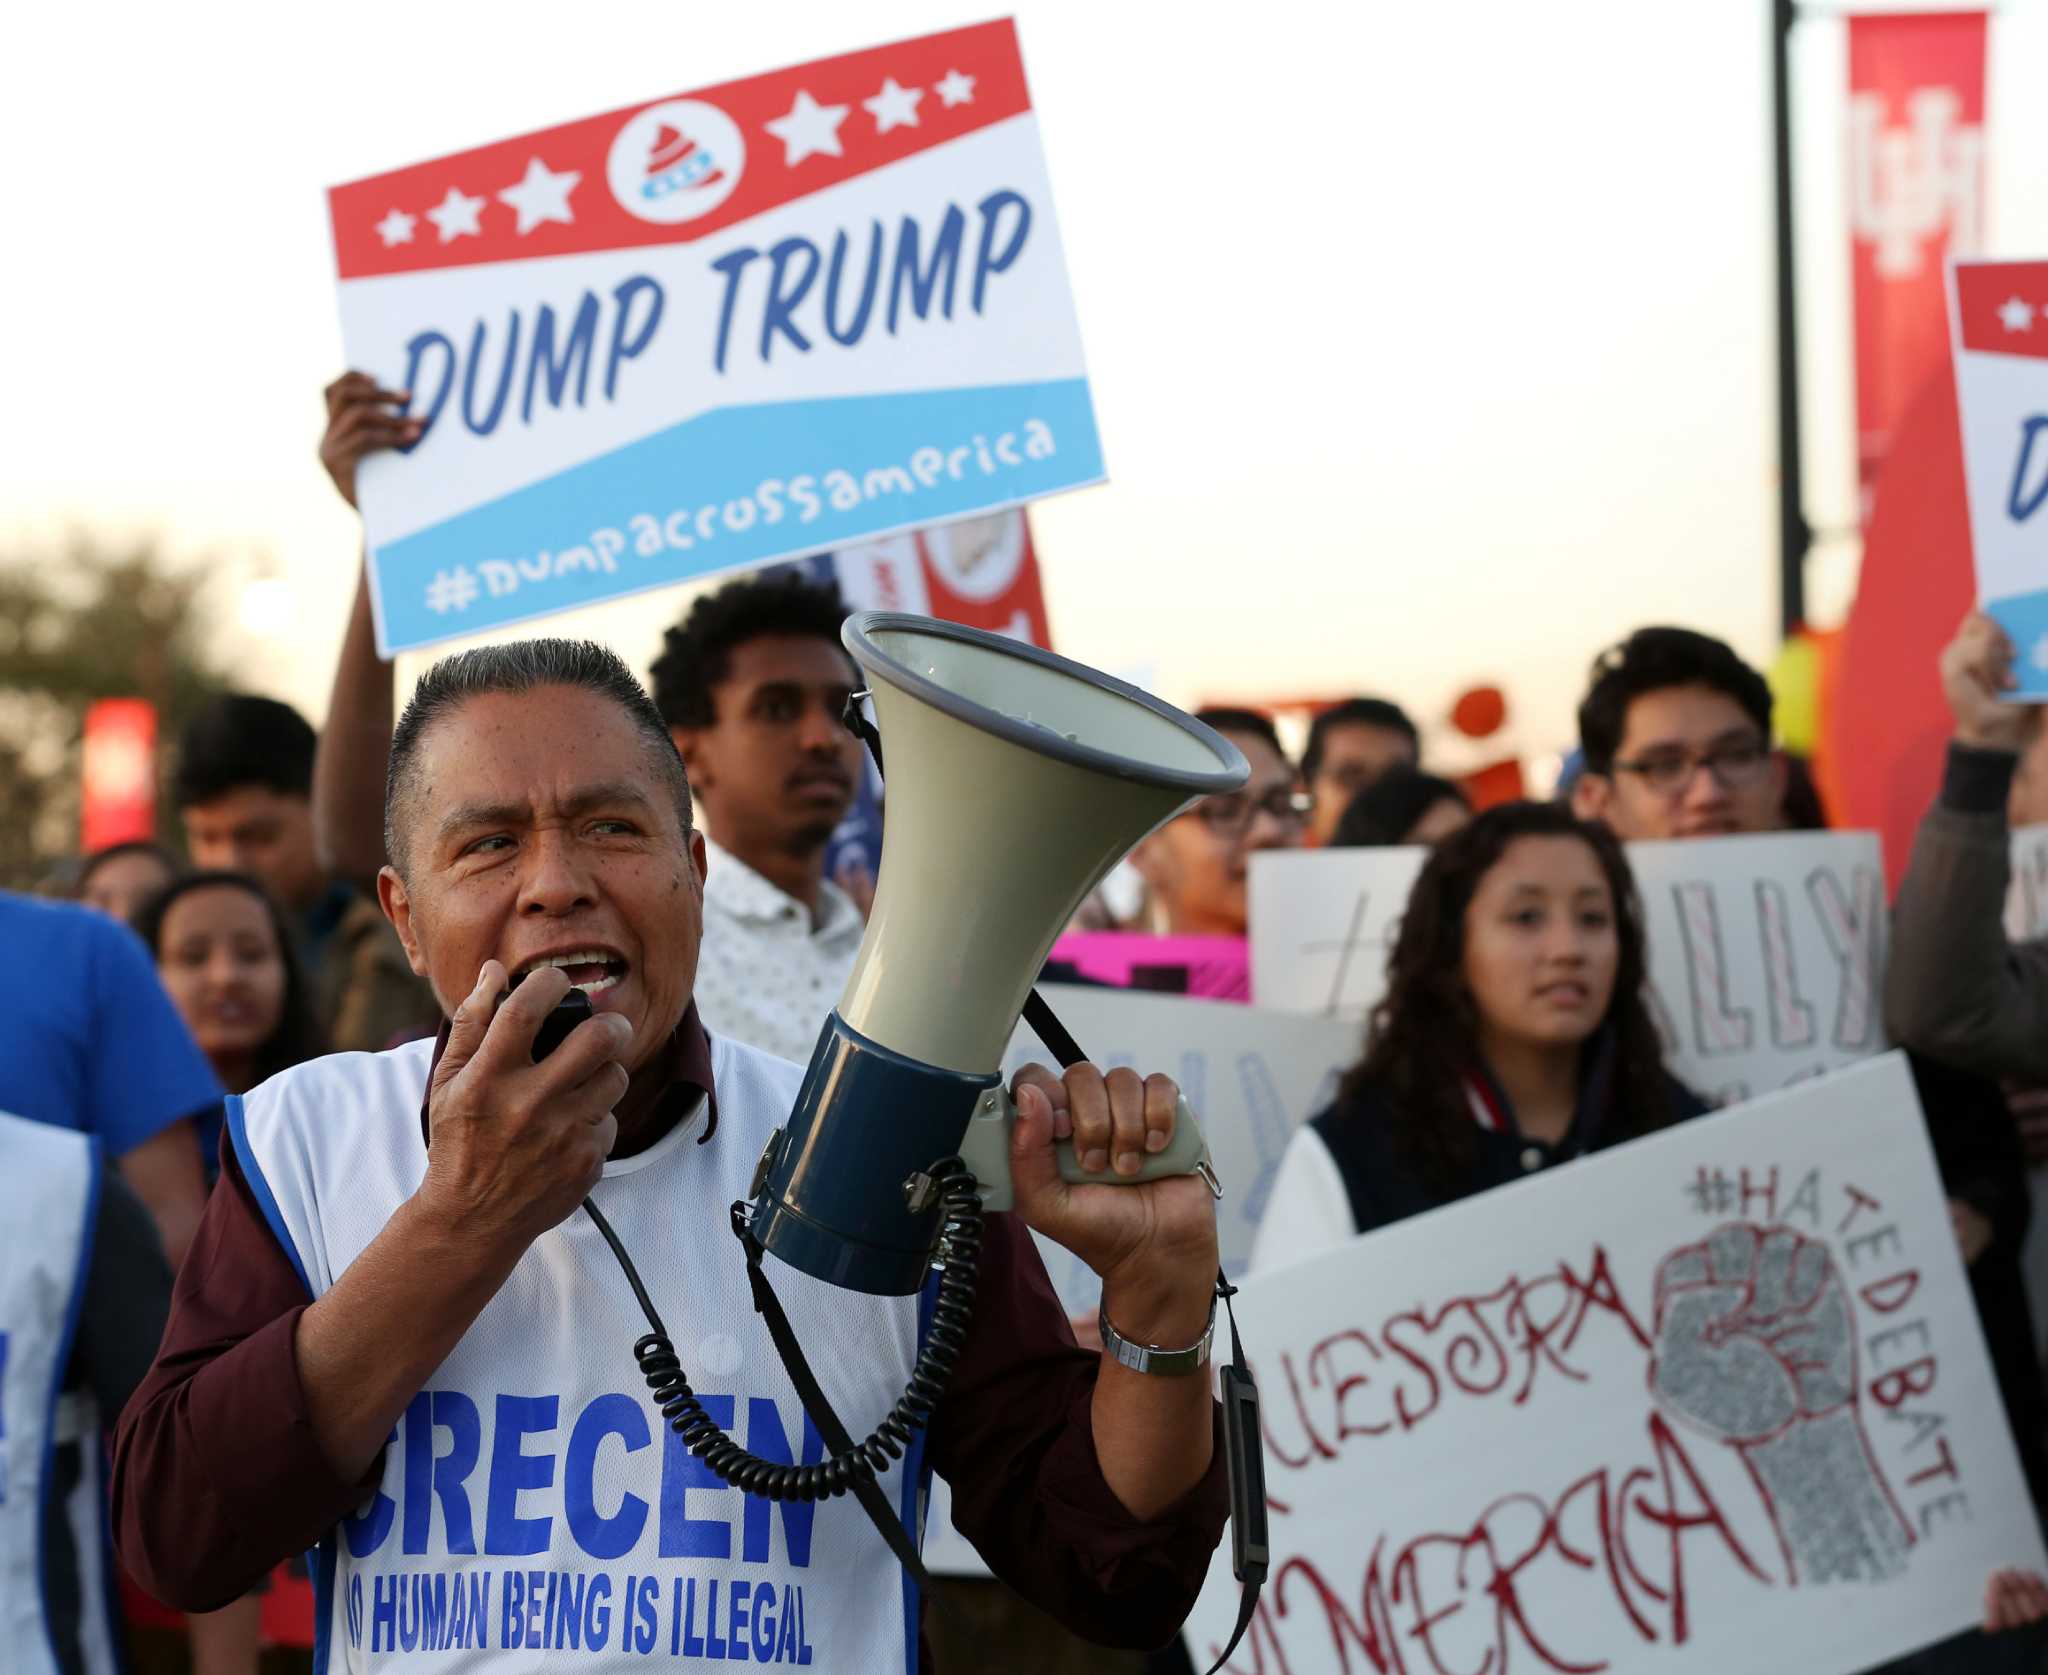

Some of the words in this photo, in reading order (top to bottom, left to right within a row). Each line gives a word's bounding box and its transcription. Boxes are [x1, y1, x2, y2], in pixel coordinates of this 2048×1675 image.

[399, 272, 666, 457] DUMP
[709, 189, 1033, 377] TRUMP
[1211, 1243, 1655, 1470] UESTRA
[371, 1571, 491, 1653] HUMAN
[501, 1571, 611, 1653] BEING
[623, 1575, 661, 1656] IS
[671, 1577, 813, 1667] ILLEGAL
